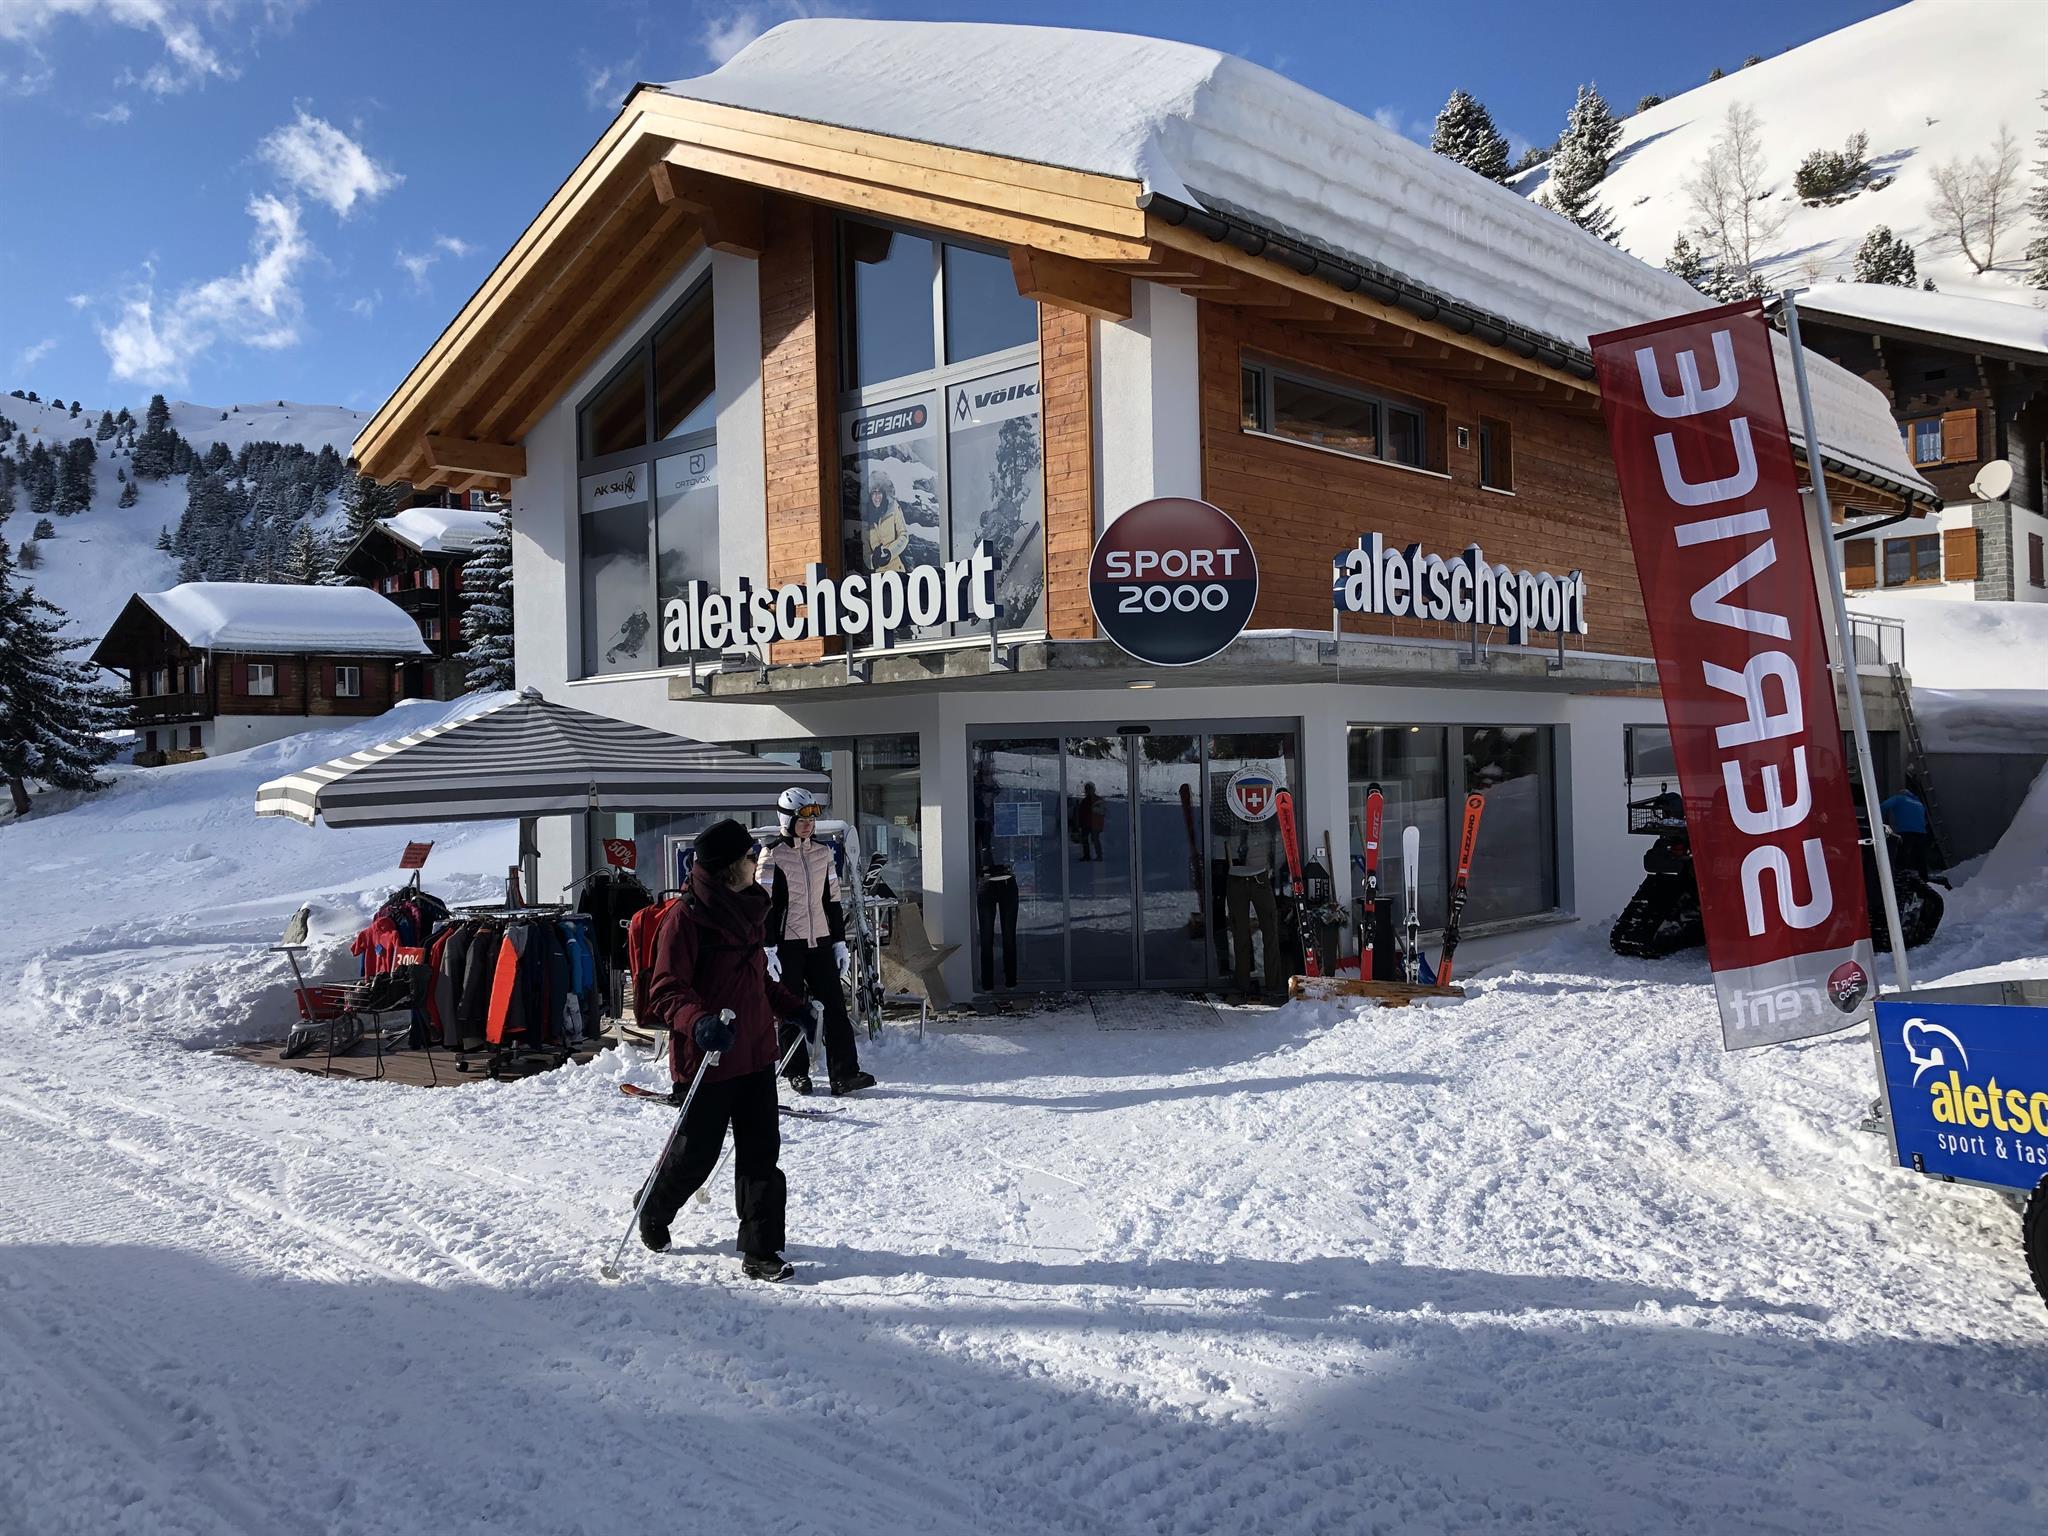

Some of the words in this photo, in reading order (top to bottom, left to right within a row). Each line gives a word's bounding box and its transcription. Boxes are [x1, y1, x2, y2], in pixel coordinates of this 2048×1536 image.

[593, 484, 608, 497] AK
[610, 481, 625, 494] Ski
[675, 474, 711, 489] ORTOVOX
[1105, 548, 1240, 579] SPORT
[663, 538, 996, 652] aletschsport
[1118, 583, 1229, 614] 2000
[1344, 532, 1588, 646] aletschsport
[608, 840, 634, 865] 50%
[1462, 814, 1475, 864] BLIZZARD
[1938, 1132, 1988, 1156] sport
[1995, 1136, 2008, 1159] &
[2015, 1139, 2048, 1165] fas
